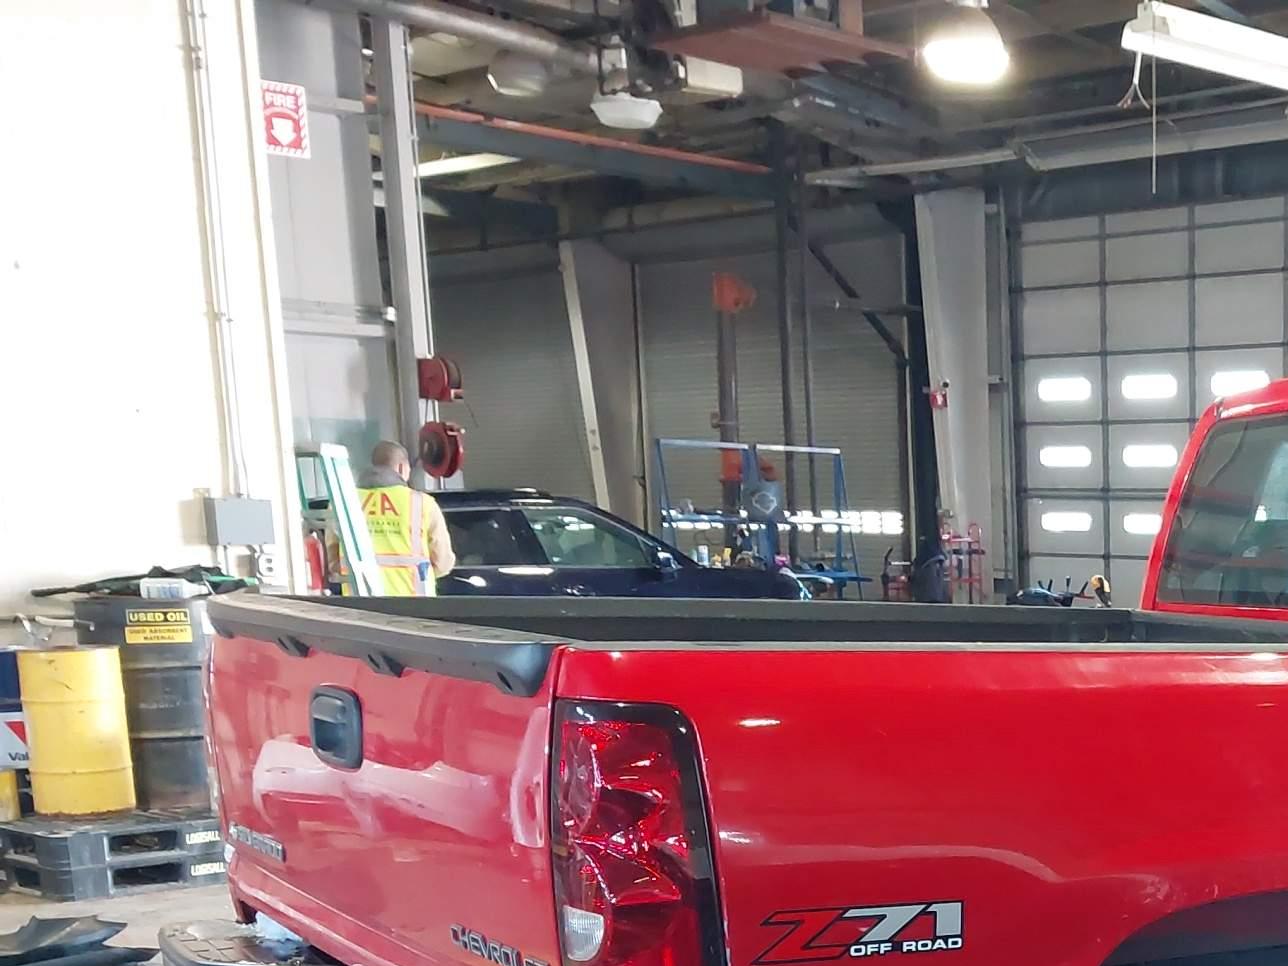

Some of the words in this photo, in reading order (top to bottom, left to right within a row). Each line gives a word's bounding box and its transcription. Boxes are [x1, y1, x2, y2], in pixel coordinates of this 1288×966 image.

[264, 91, 297, 110] FIRE
[129, 612, 165, 622] USED
[166, 612, 187, 622] OIL
[751, 900, 964, 966] Z71
[849, 943, 893, 957] OFF
[902, 937, 963, 952] ROAD
